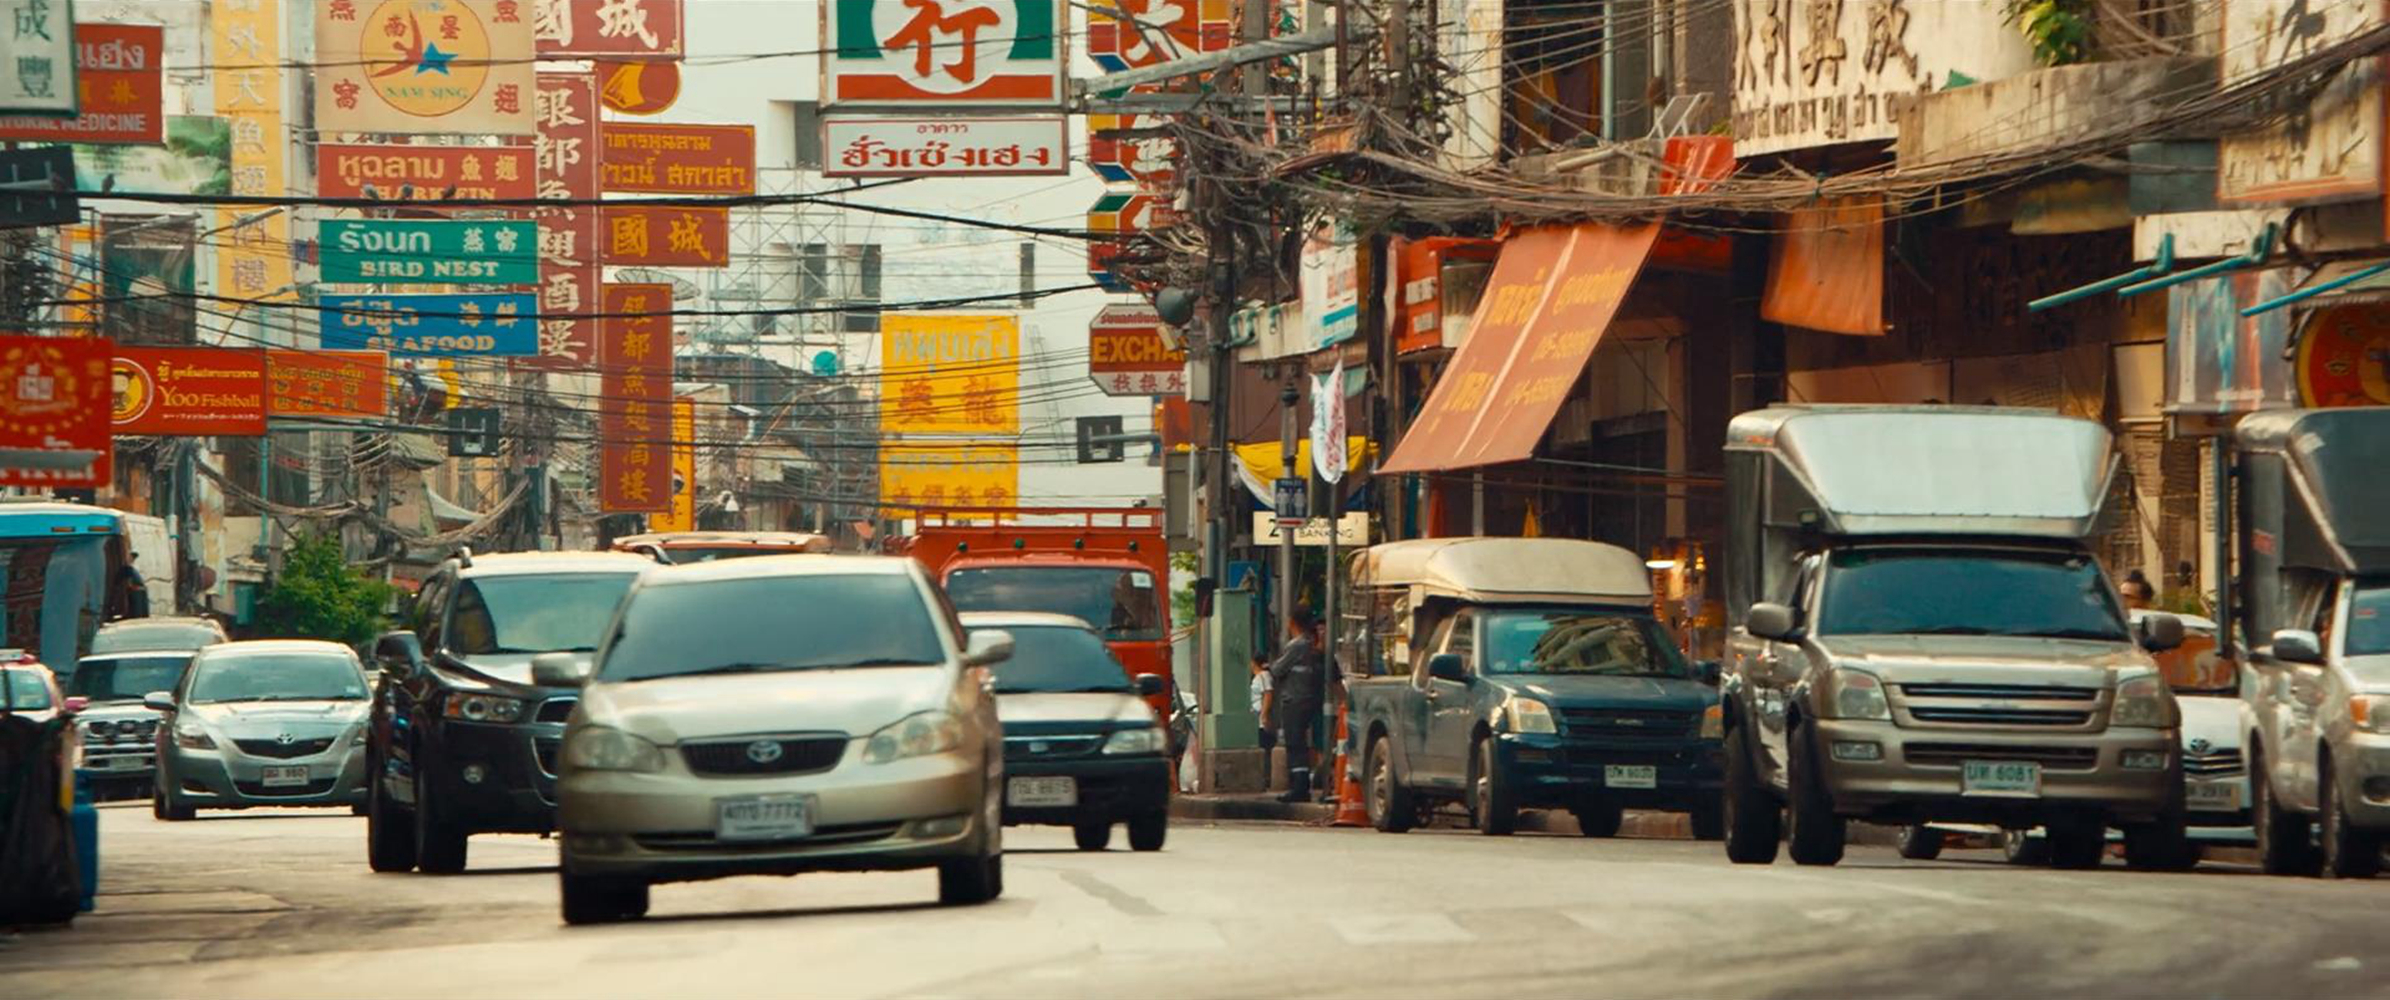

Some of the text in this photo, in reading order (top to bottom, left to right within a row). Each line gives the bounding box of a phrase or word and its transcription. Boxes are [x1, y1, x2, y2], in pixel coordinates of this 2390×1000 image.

[61, 113, 147, 132] MEDICINE
[338, 154, 445, 186] หูฉลาม
[338, 223, 431, 253] รังนก
[611, 212, 712, 261] 國城
[360, 261, 499, 277] BIRD NEST
